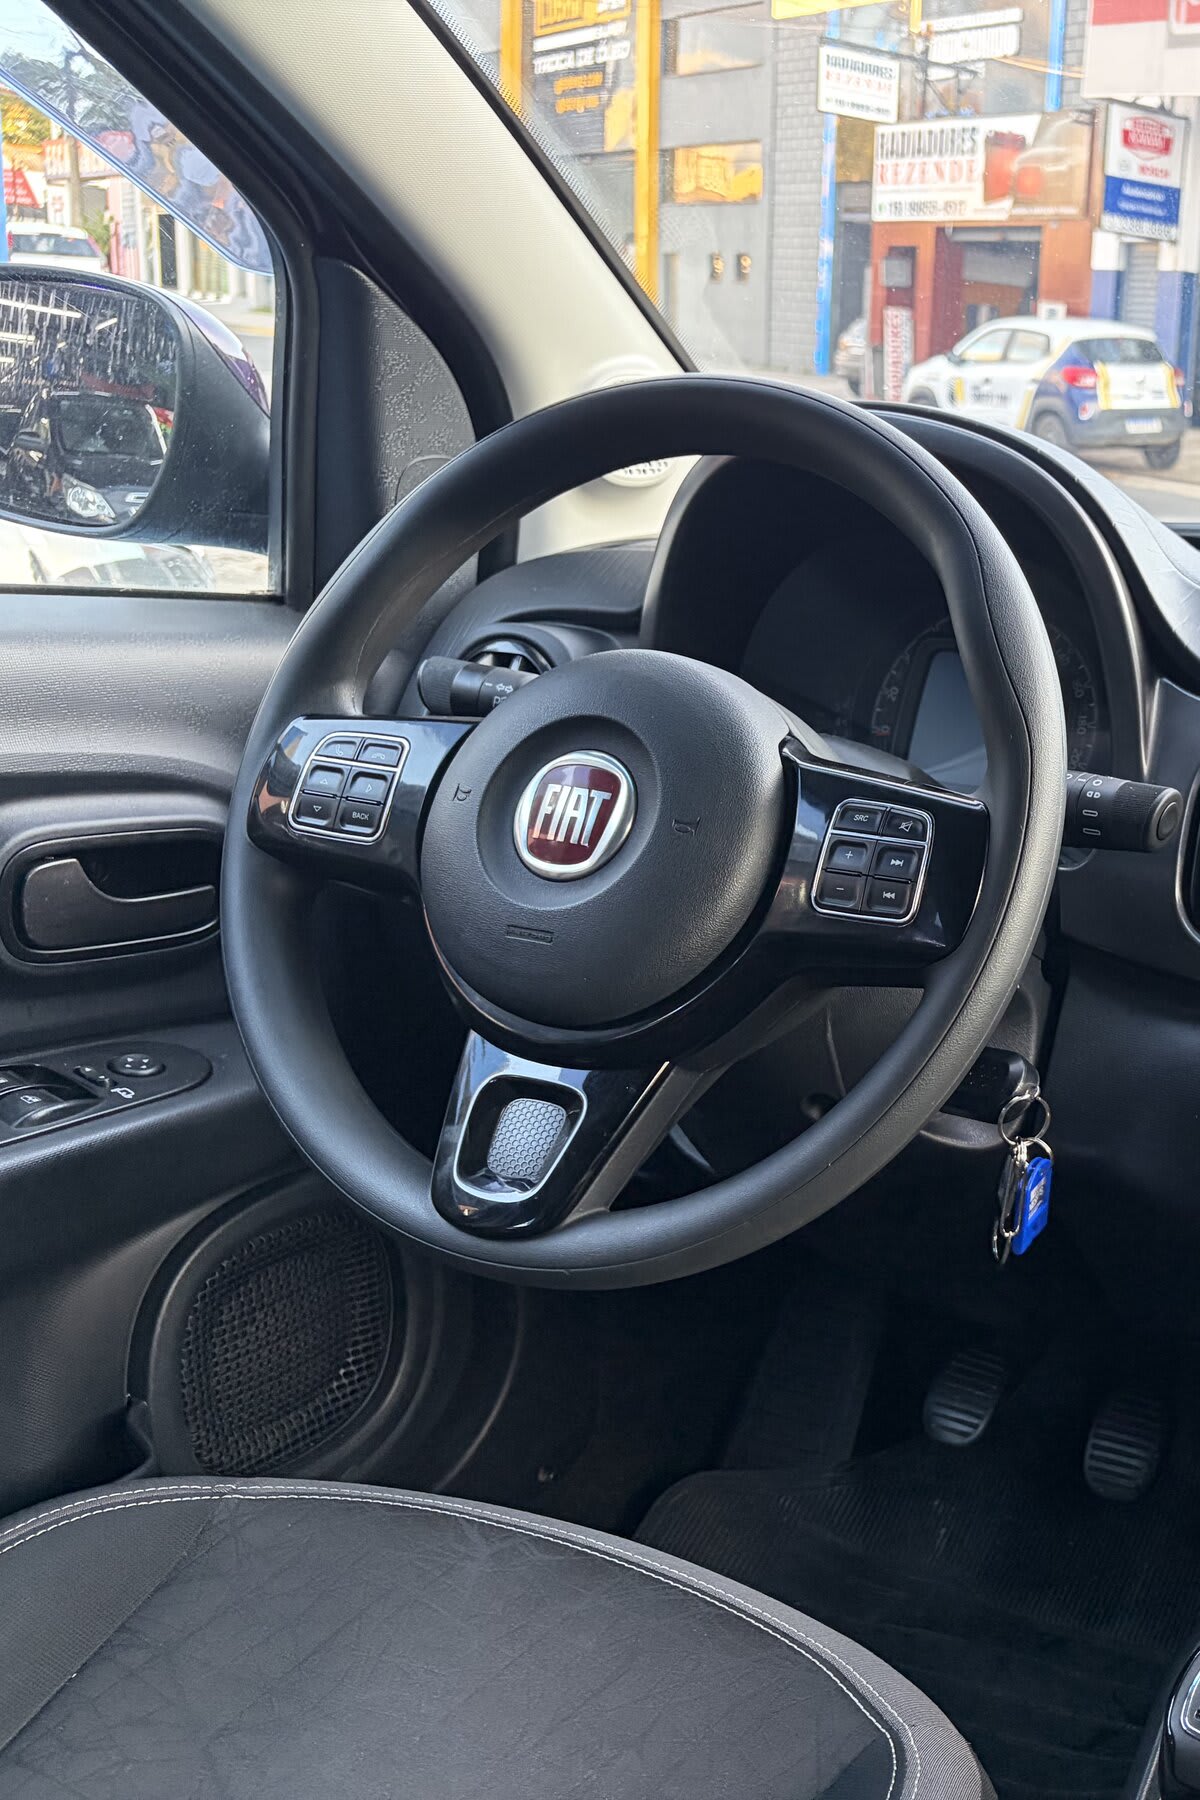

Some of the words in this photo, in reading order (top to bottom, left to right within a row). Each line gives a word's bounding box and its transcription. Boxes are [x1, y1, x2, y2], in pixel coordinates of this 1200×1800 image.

[876, 127, 979, 161] RADIADORES
[876, 159, 979, 186] REZENDE
[352, 811, 370, 820] BACK
[532, 783, 612, 848] FIAT
[853, 814, 869, 822] SRC
